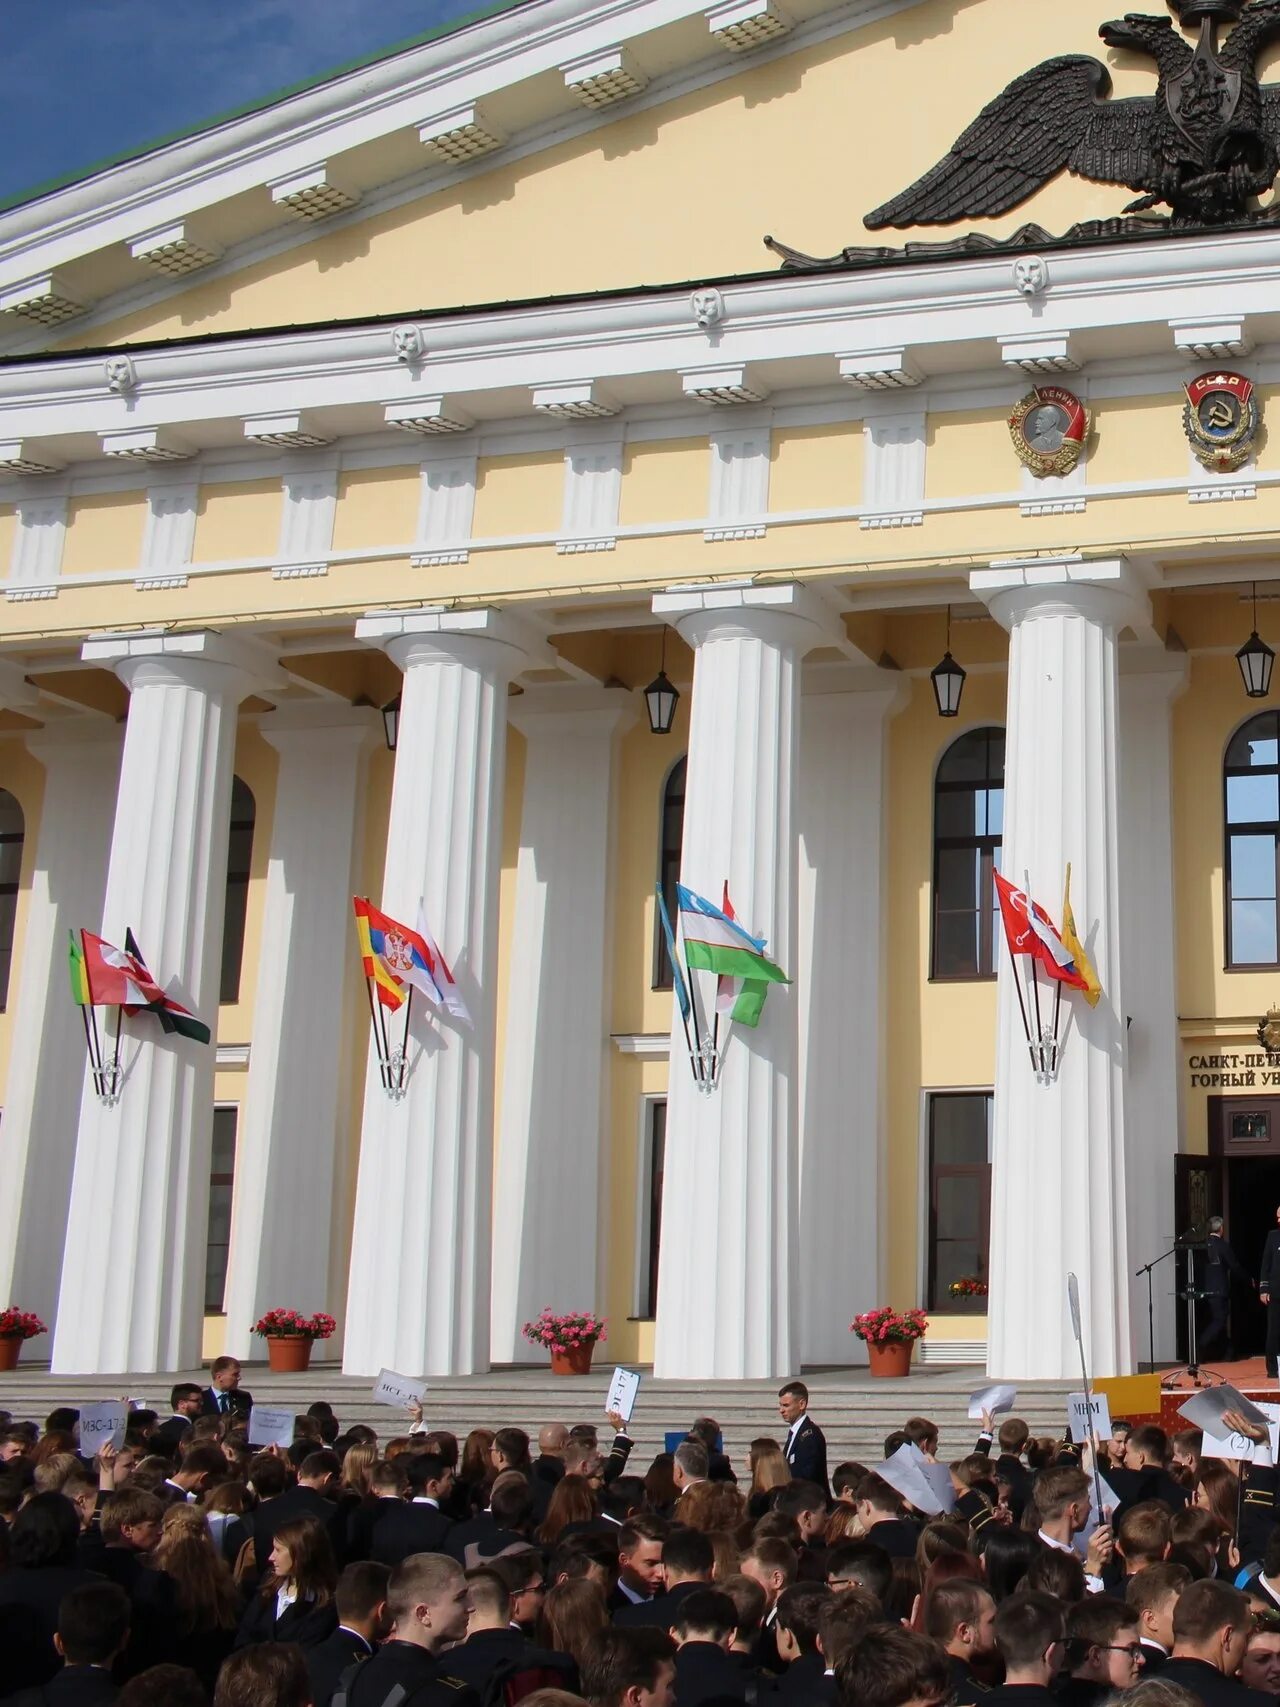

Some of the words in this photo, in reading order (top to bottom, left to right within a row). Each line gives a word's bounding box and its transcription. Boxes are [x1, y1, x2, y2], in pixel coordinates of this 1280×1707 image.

[1196, 375, 1240, 390] СССР
[1042, 390, 1075, 406] ЛЕНИН
[1191, 1070, 1256, 1087] ГОРНЫЙ
[1230, 1434, 1251, 1453] (2)
